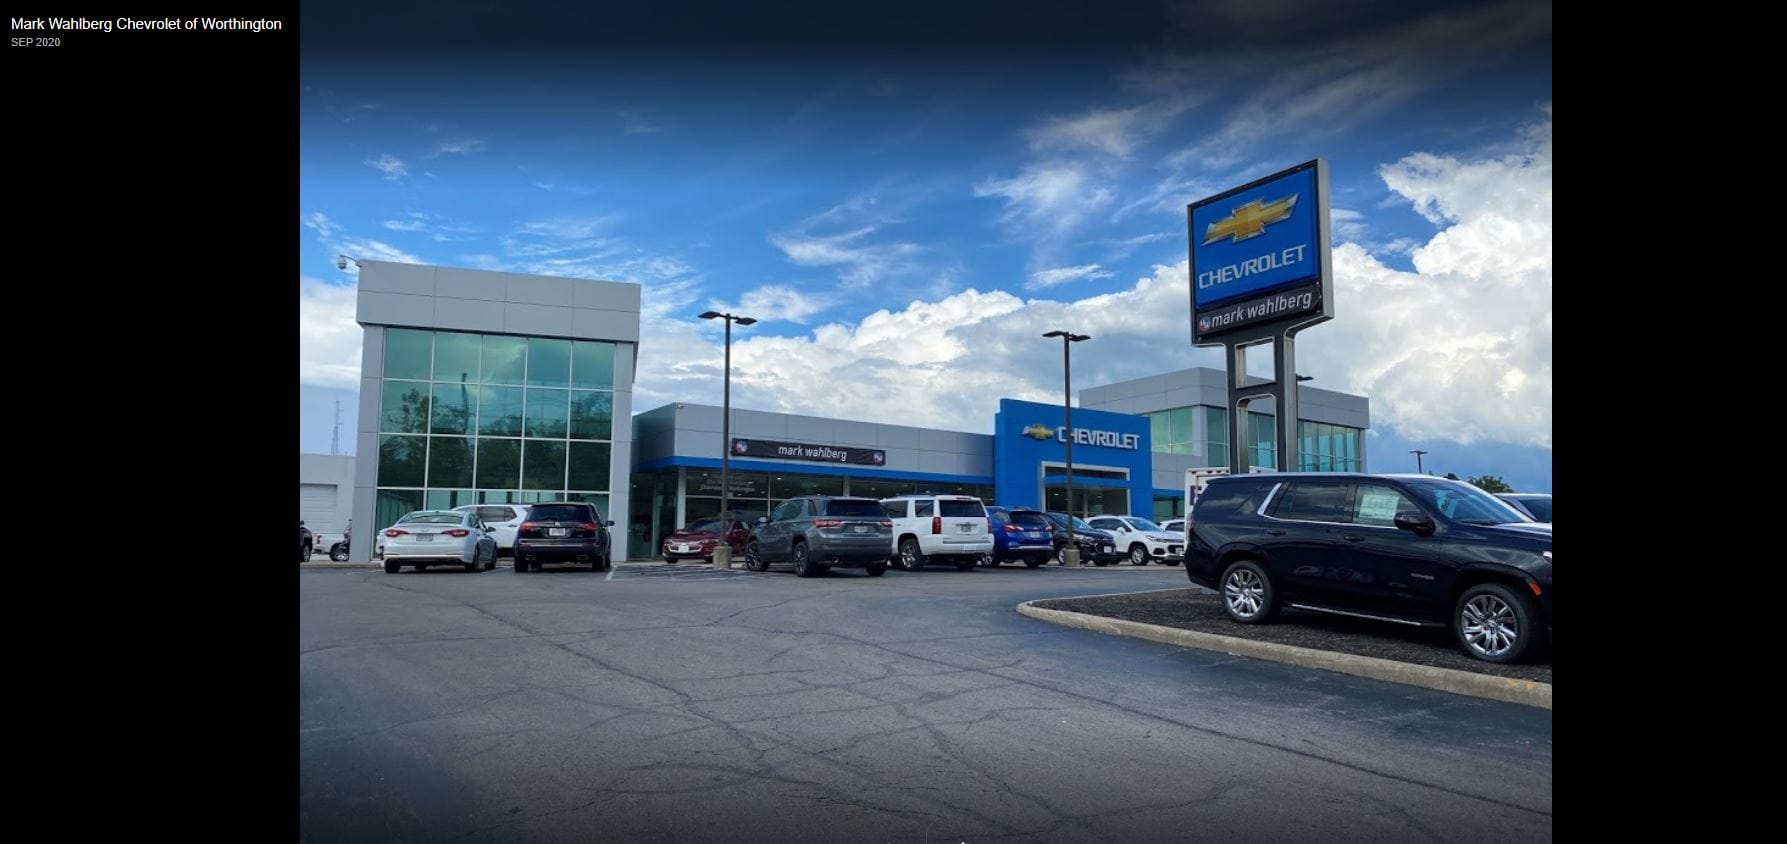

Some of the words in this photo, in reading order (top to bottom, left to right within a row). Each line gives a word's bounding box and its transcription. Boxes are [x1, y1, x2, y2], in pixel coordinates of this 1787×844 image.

[1199, 244, 1306, 289] CHEVROLET
[1212, 306, 1245, 328] mark
[1247, 293, 1312, 318] wahlberg
[1058, 427, 1140, 450] CHEVROLET
[778, 445, 803, 457] mark
[804, 446, 847, 462] wahlberg
